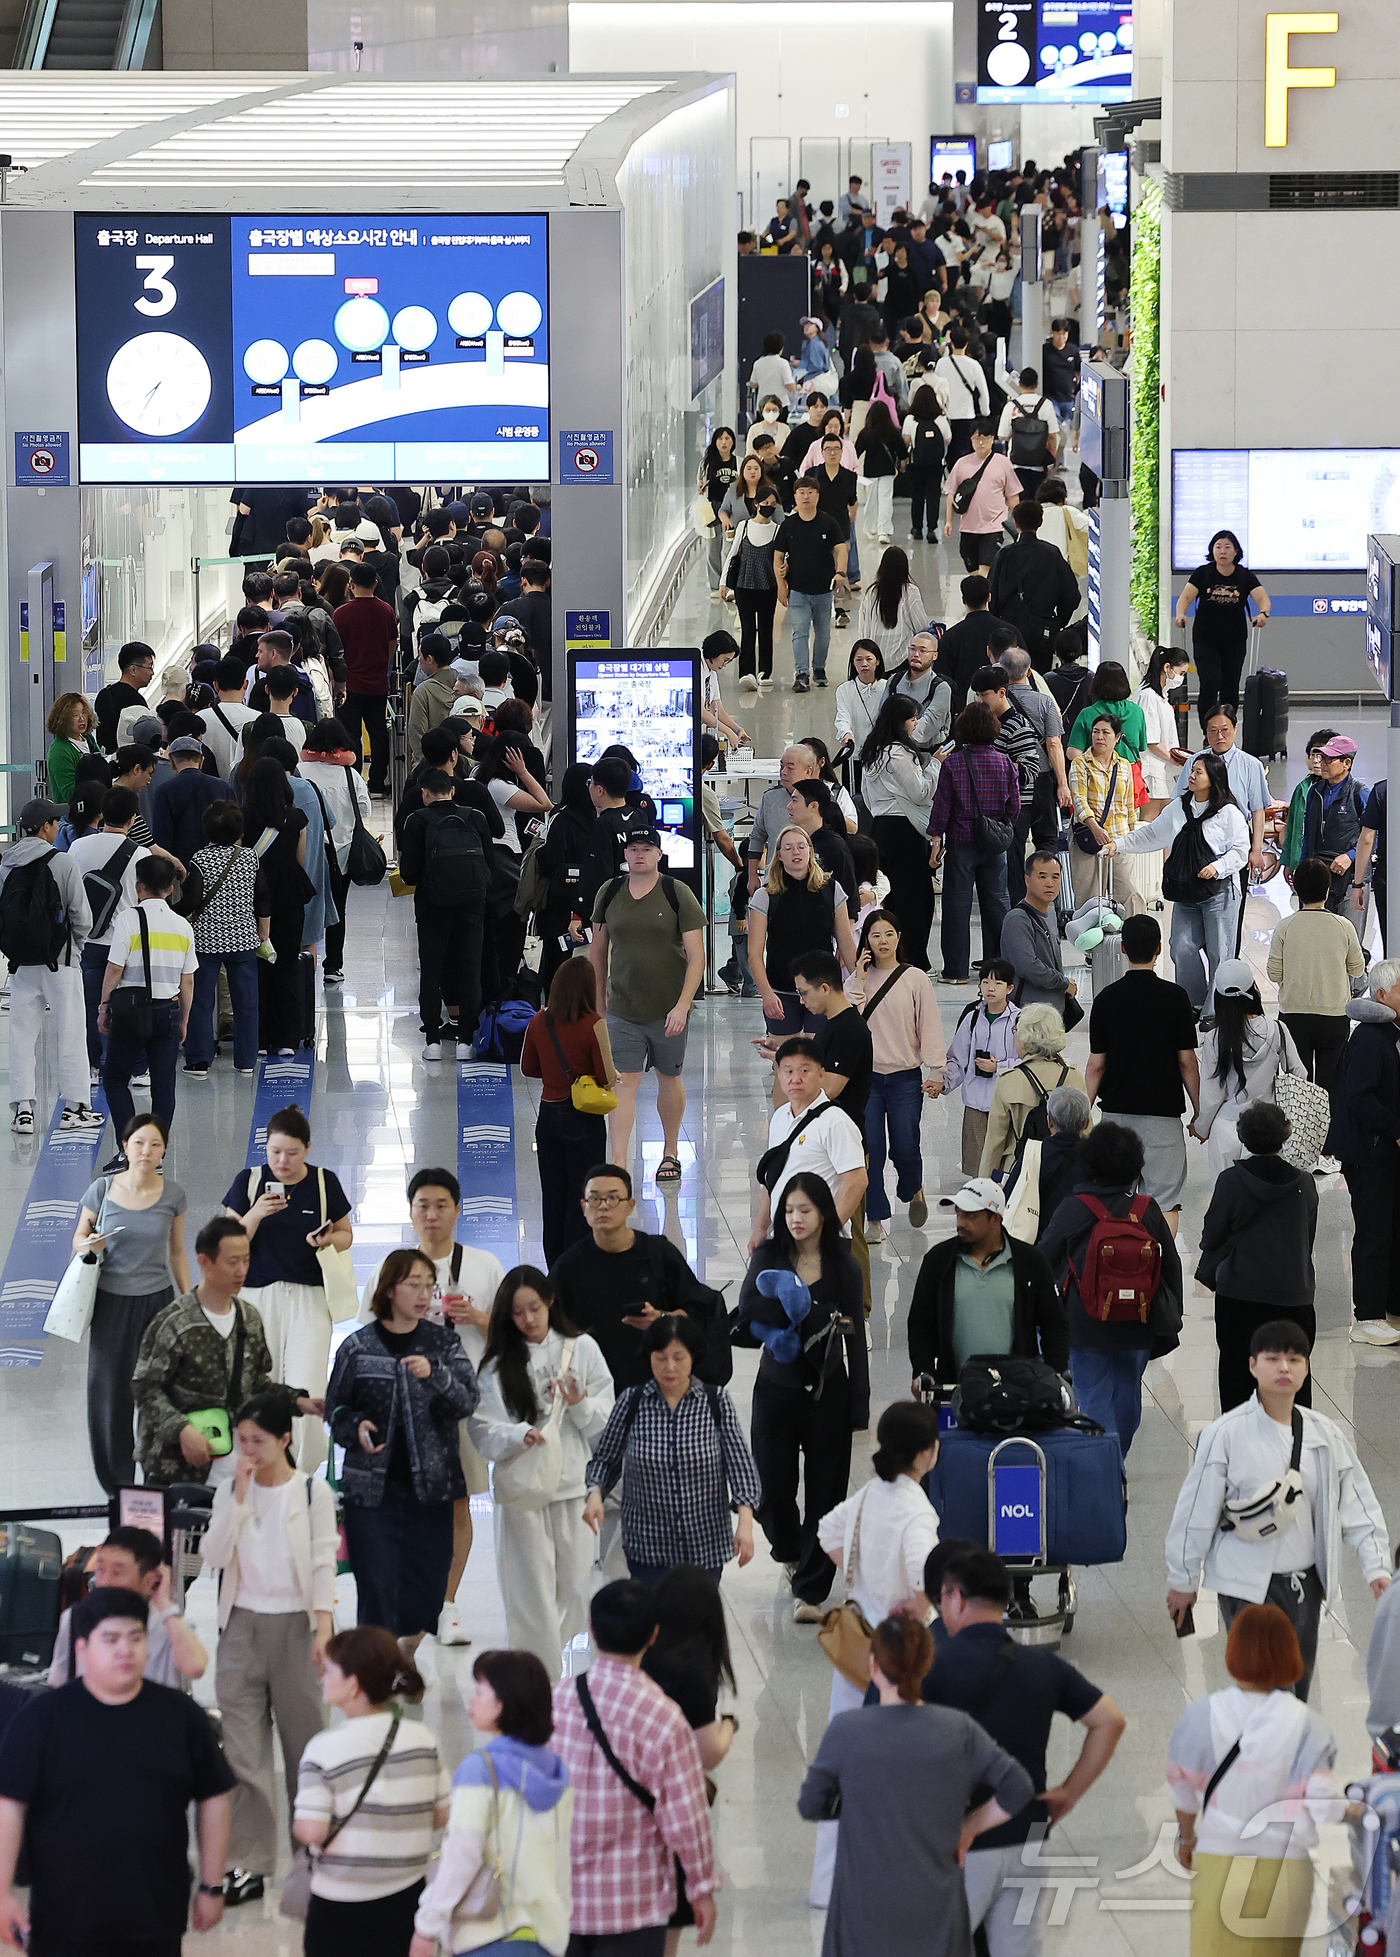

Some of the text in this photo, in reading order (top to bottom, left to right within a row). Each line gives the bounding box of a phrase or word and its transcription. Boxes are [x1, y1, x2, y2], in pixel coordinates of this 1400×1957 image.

[998, 12, 1018, 41] 2
[1264, 12, 1339, 148] F
[97, 229, 214, 246] 출국장 Departure Hall
[248, 228, 418, 247] 출국장별 예상소요시간 안내
[133, 254, 178, 317] 3
[22, 434, 62, 442] 사진촬영금지
[496, 426, 540, 437] 시범 운영중
[567, 433, 606, 441] 사진촬영금지
[154, 449, 205, 464] Passport
[313, 449, 364, 463] Passport
[470, 449, 521, 462] Passport
[578, 614, 598, 622] 환송객
[598, 662, 669, 672] 출국장별 대기열 상황
[630, 680, 652, 688] 출국장
[631, 720, 652, 728] 출국장
[1001, 1504, 1034, 1518] NOL
